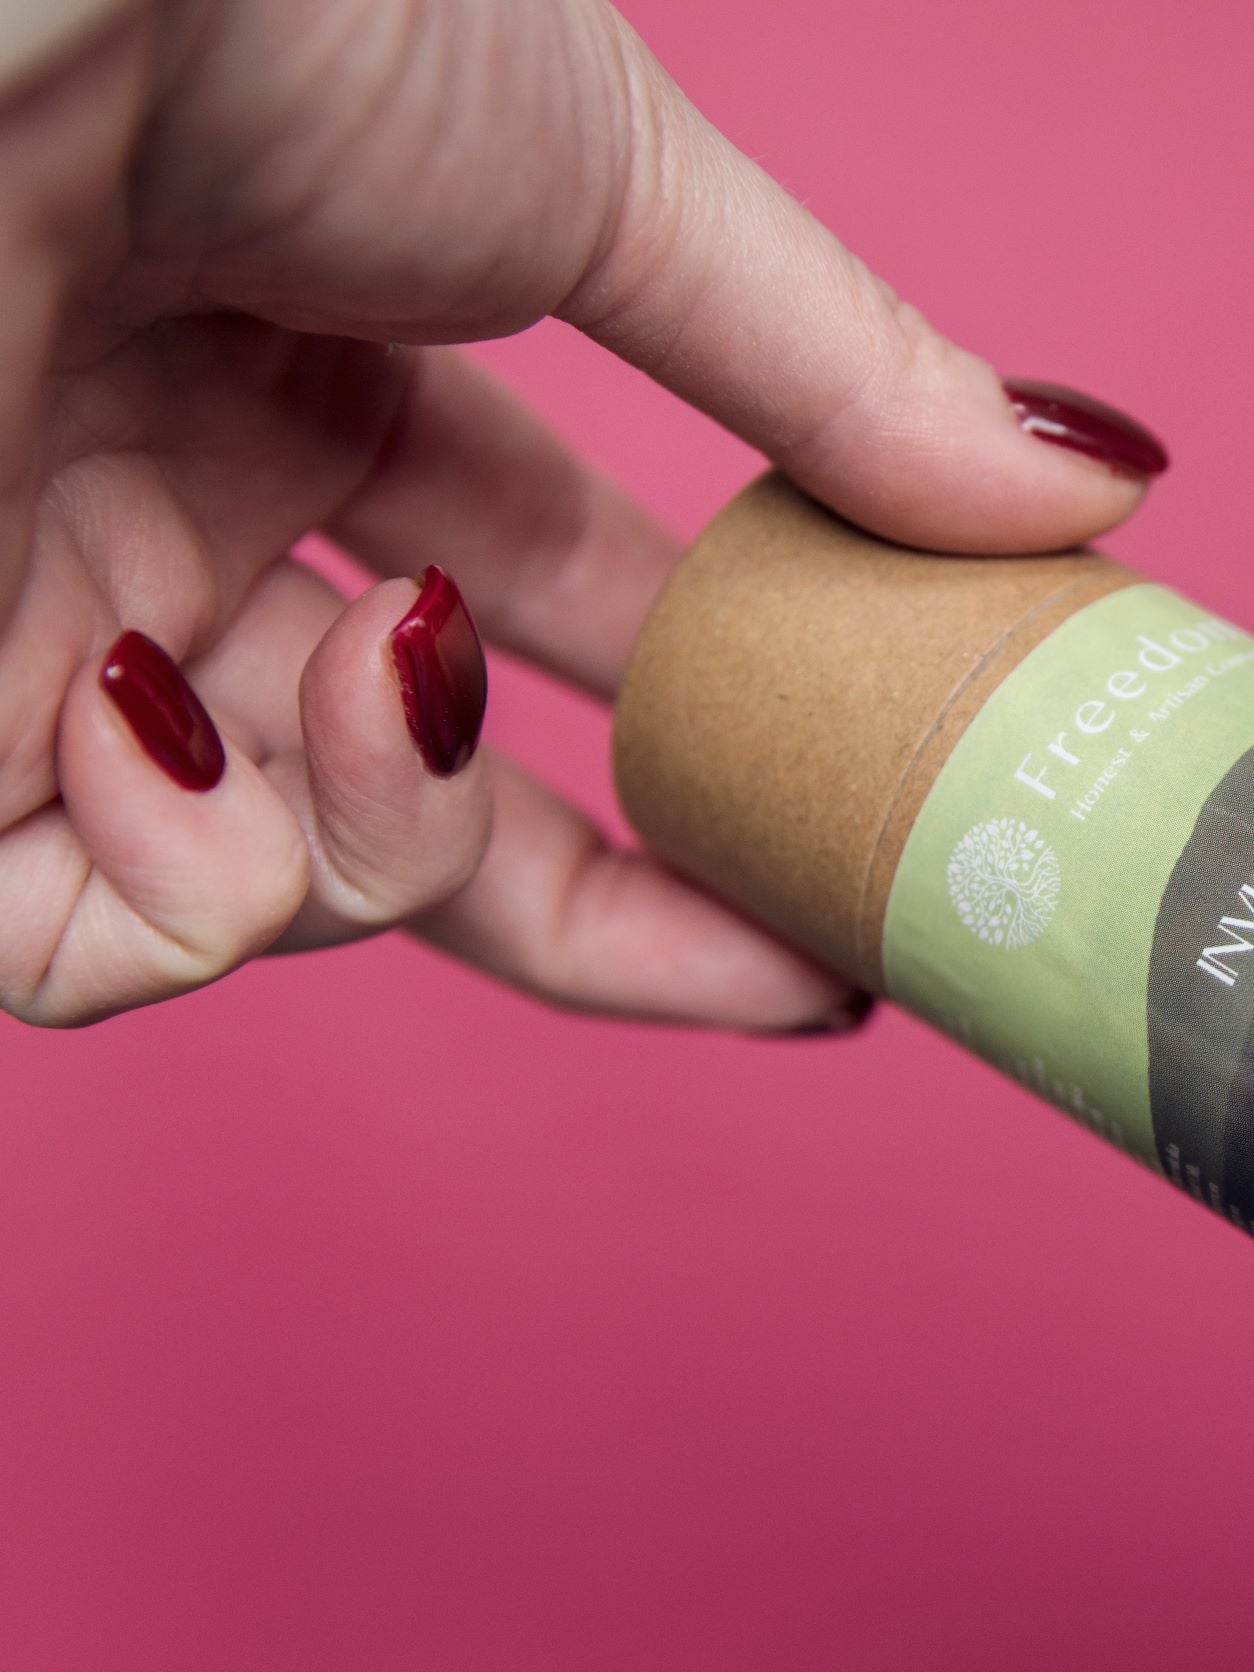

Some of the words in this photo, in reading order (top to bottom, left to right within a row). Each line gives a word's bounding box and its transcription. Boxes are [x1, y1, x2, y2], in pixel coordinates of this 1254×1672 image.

[1071, 747, 1132, 822] Honest
[1129, 728, 1150, 743] &
[1148, 674, 1209, 723] Artisan
